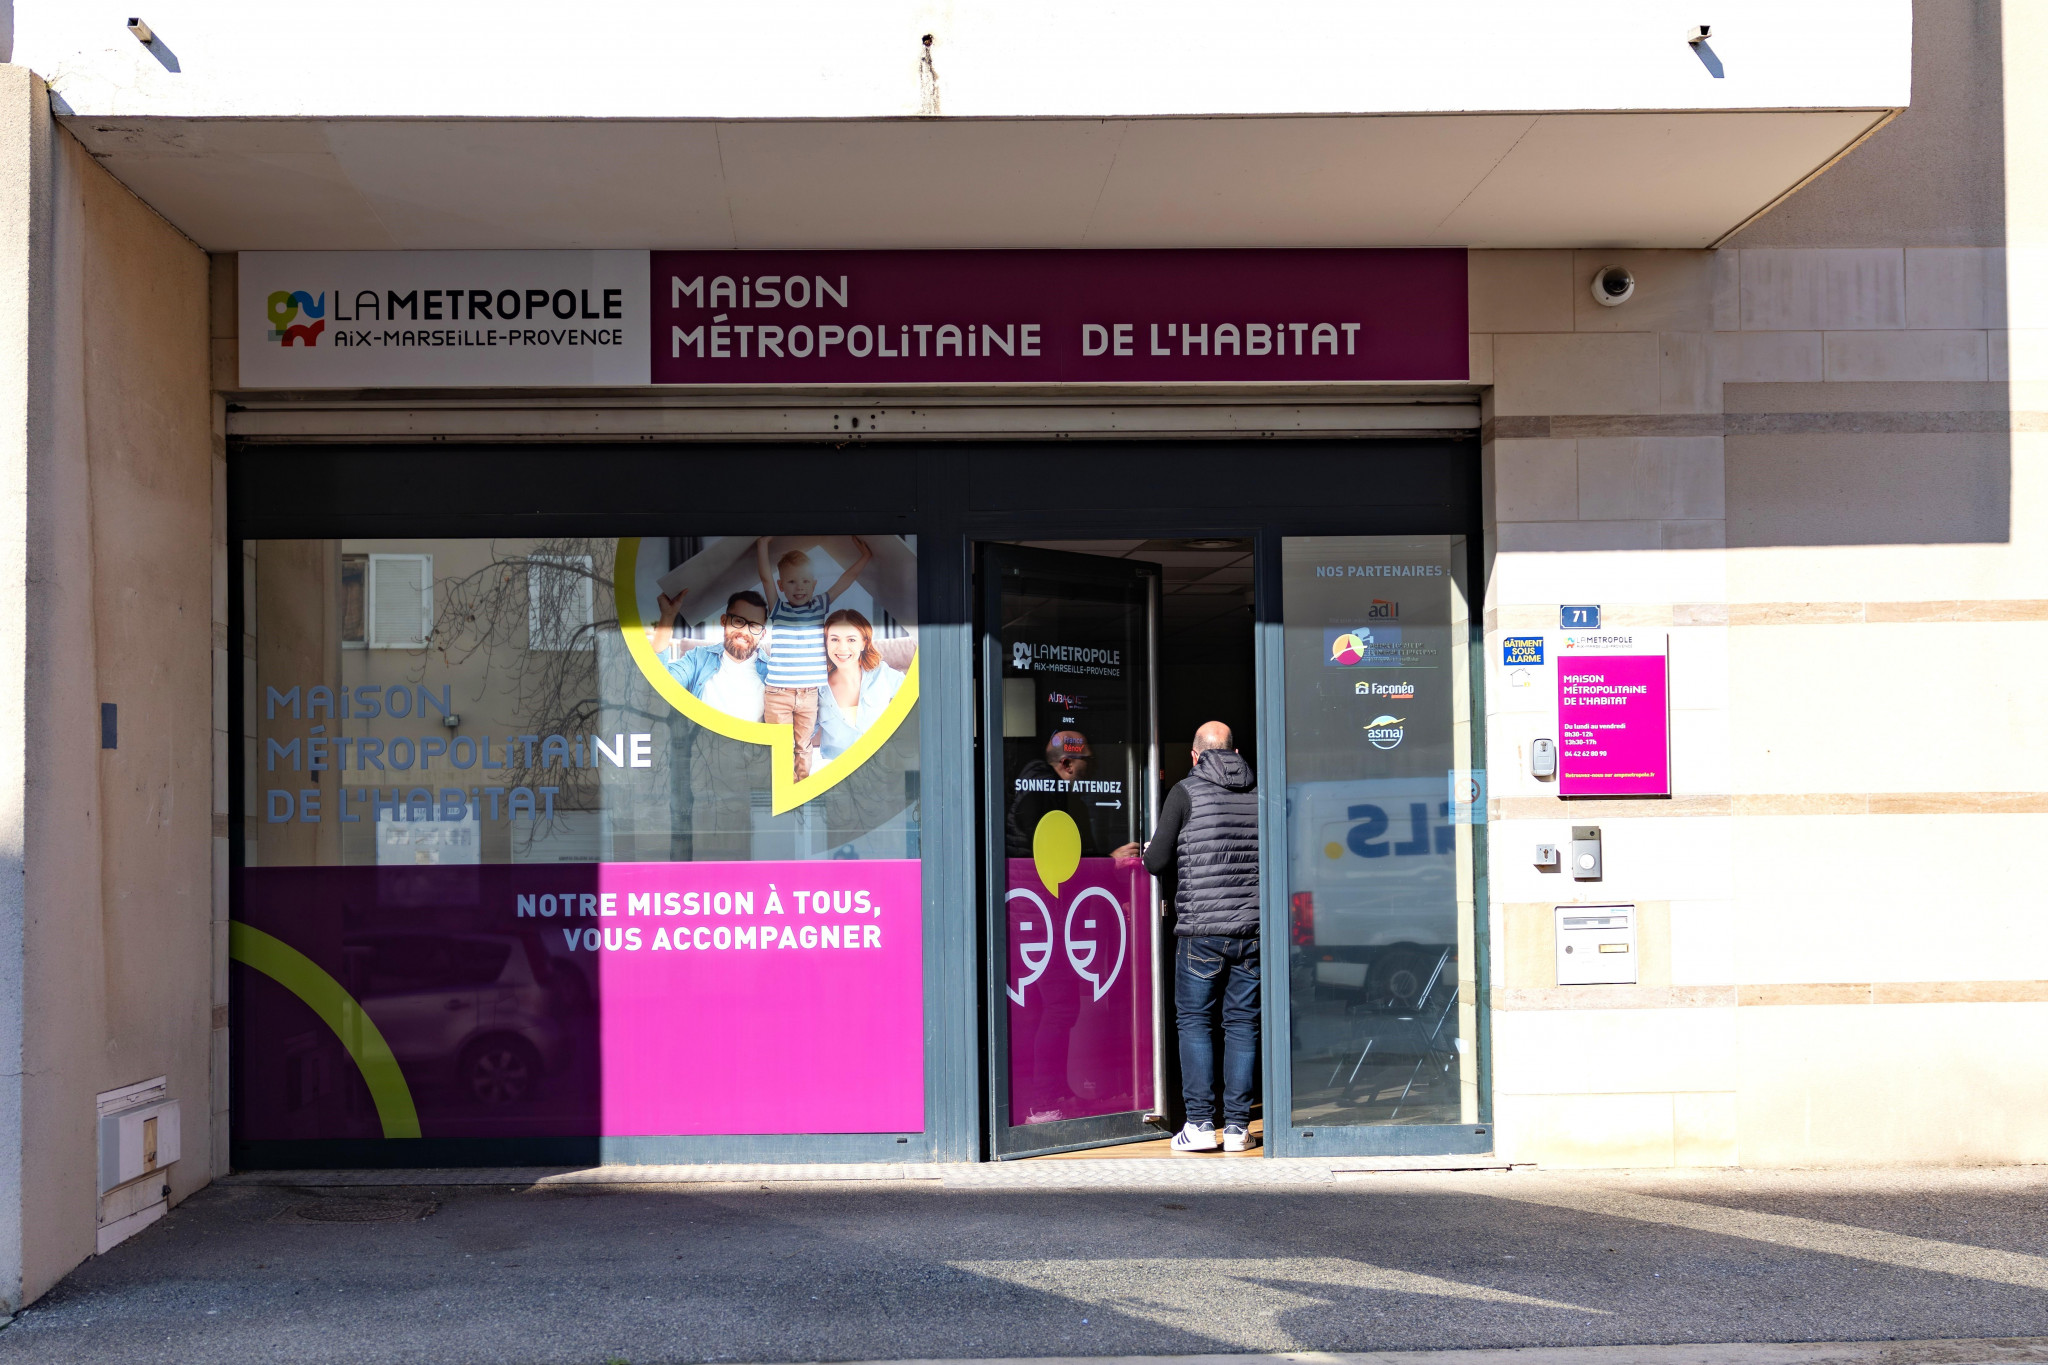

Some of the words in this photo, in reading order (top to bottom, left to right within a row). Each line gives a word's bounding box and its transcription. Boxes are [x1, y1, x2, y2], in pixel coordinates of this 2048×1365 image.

[672, 275, 848, 309] MAiSON
[672, 313, 1041, 358] MÉTROPOLiTAiNE
[1082, 323, 1133, 356] DE
[1152, 322, 1361, 356] L'HABiTAT
[1316, 566, 1344, 577] NOS
[1348, 565, 1442, 577] PARTENAIRES
[1572, 610, 1588, 623] 71
[1504, 638, 1543, 648] BÂTIMENT
[1512, 647, 1536, 655] SOUS
[1506, 655, 1542, 663] ALARME
[1372, 682, 1414, 698] Façonéo
[266, 684, 452, 720] MAiSON
[1564, 697, 1577, 706] DE
[1062, 716, 1075, 724] avec
[1063, 736, 1083, 744] France
[266, 725, 652, 772] MÉTROPOLiTAiNE
[1015, 778, 1056, 792] SONNEZ
[1058, 779, 1070, 792] ET
[1072, 780, 1122, 793] ATTENDEZ
[267, 789, 321, 824] DE
[339, 786, 560, 823] L'HABiTAT
[516, 893, 617, 918] NOTRE
[628, 891, 754, 917] MISSION
[763, 883, 785, 915] À
[793, 890, 881, 919] TOUS,
[562, 928, 642, 952] VOUS
[651, 925, 882, 951] ACCOMPAGNER
